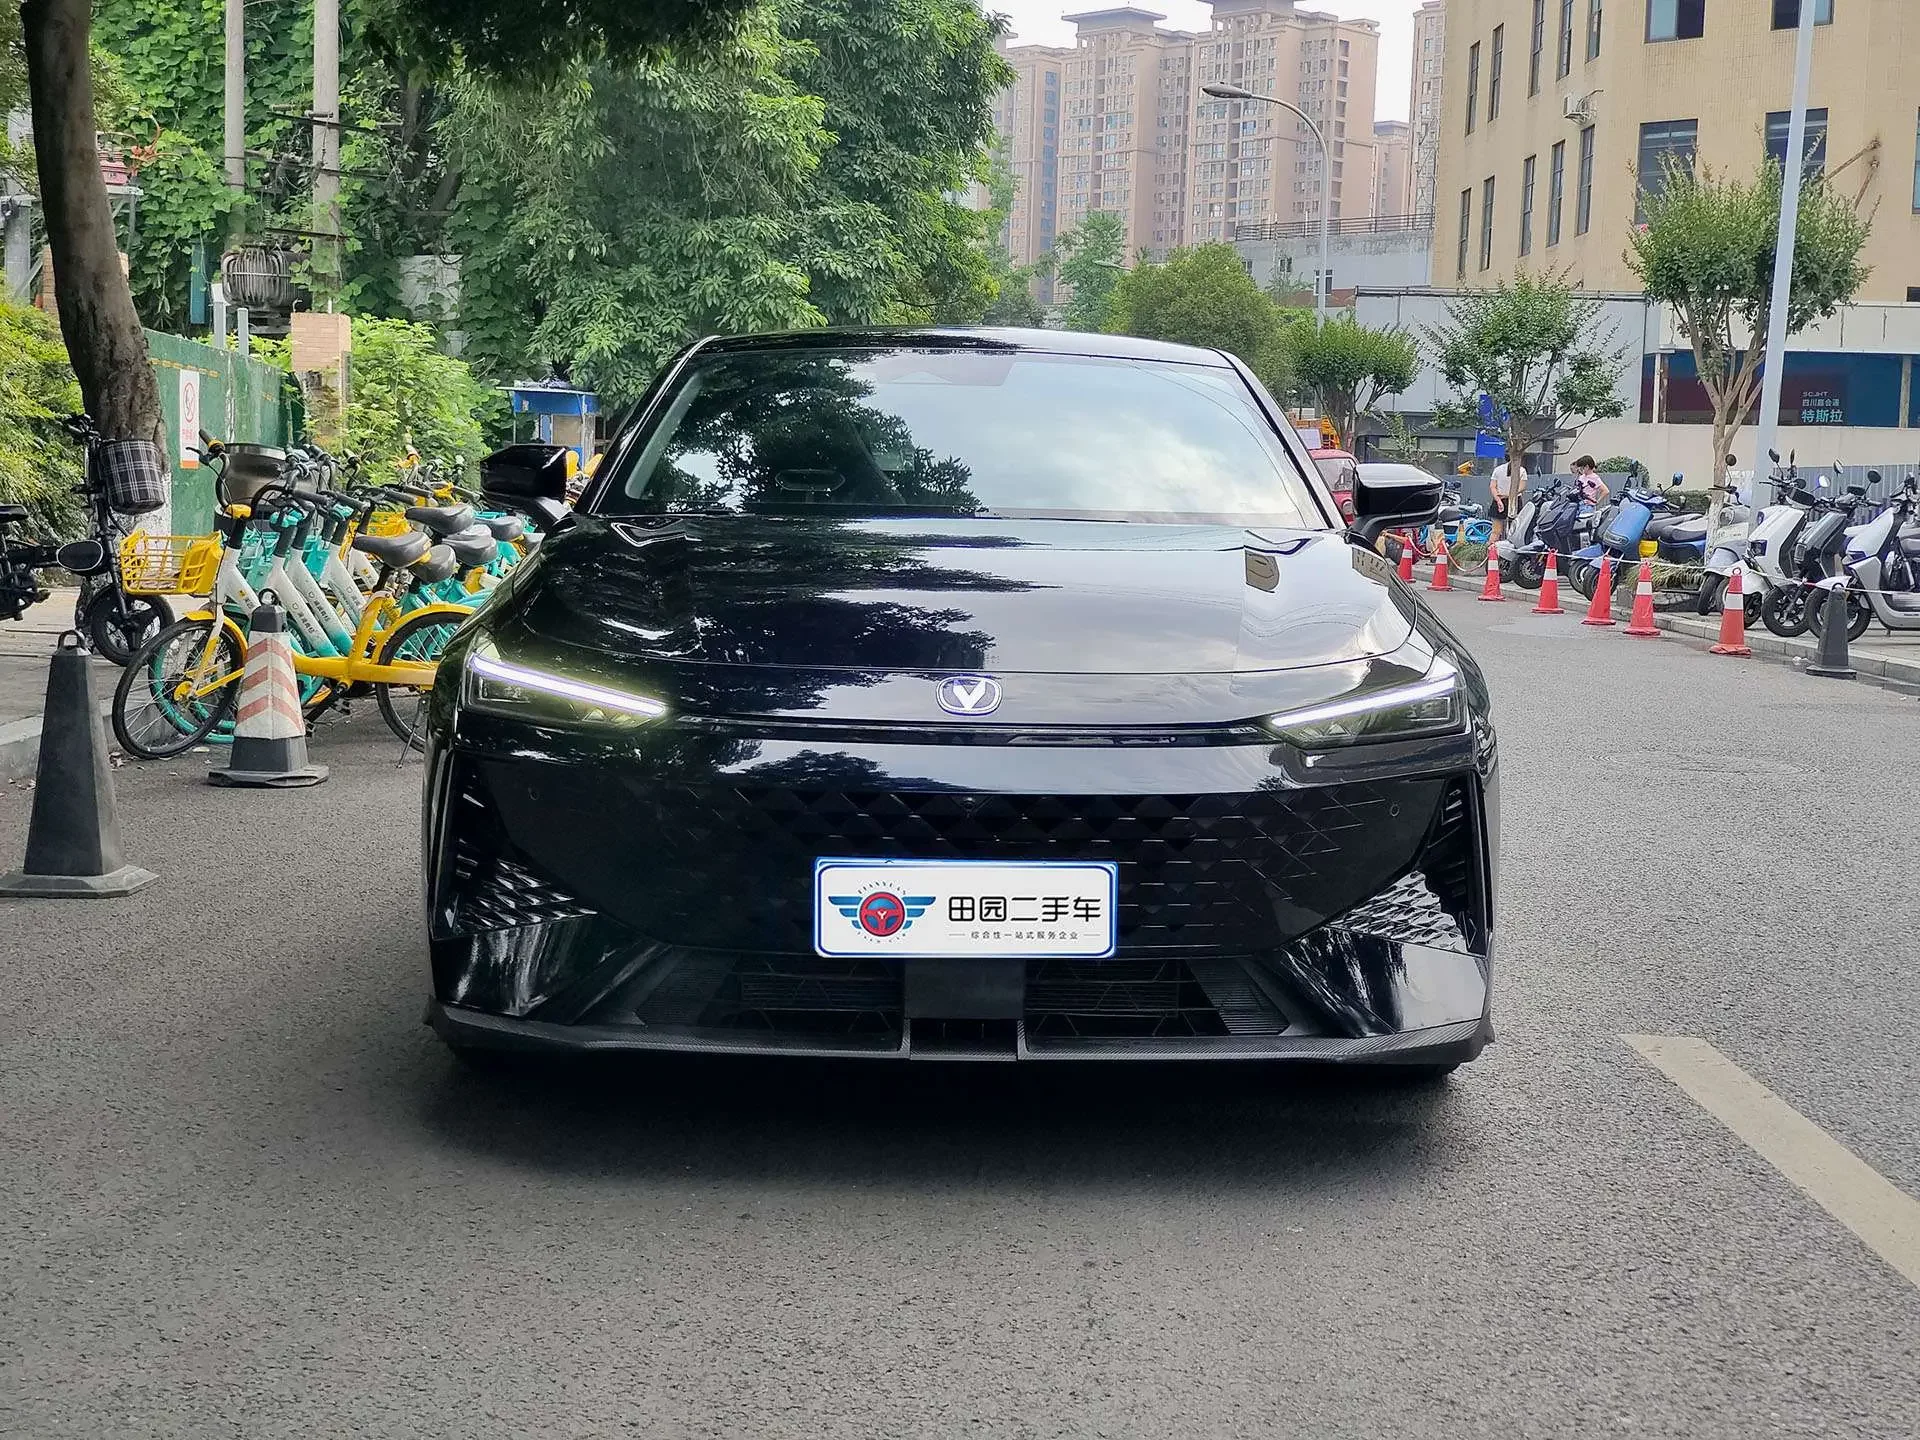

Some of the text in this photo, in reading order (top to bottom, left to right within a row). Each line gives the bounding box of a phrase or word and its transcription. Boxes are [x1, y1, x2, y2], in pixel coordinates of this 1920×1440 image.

[1801, 409, 1844, 423] 特斯拉
[877, 910, 887, 920] Y
[948, 896, 1101, 922] 田园二手车
[970, 930, 1079, 940] 综合性一站式服务企业
